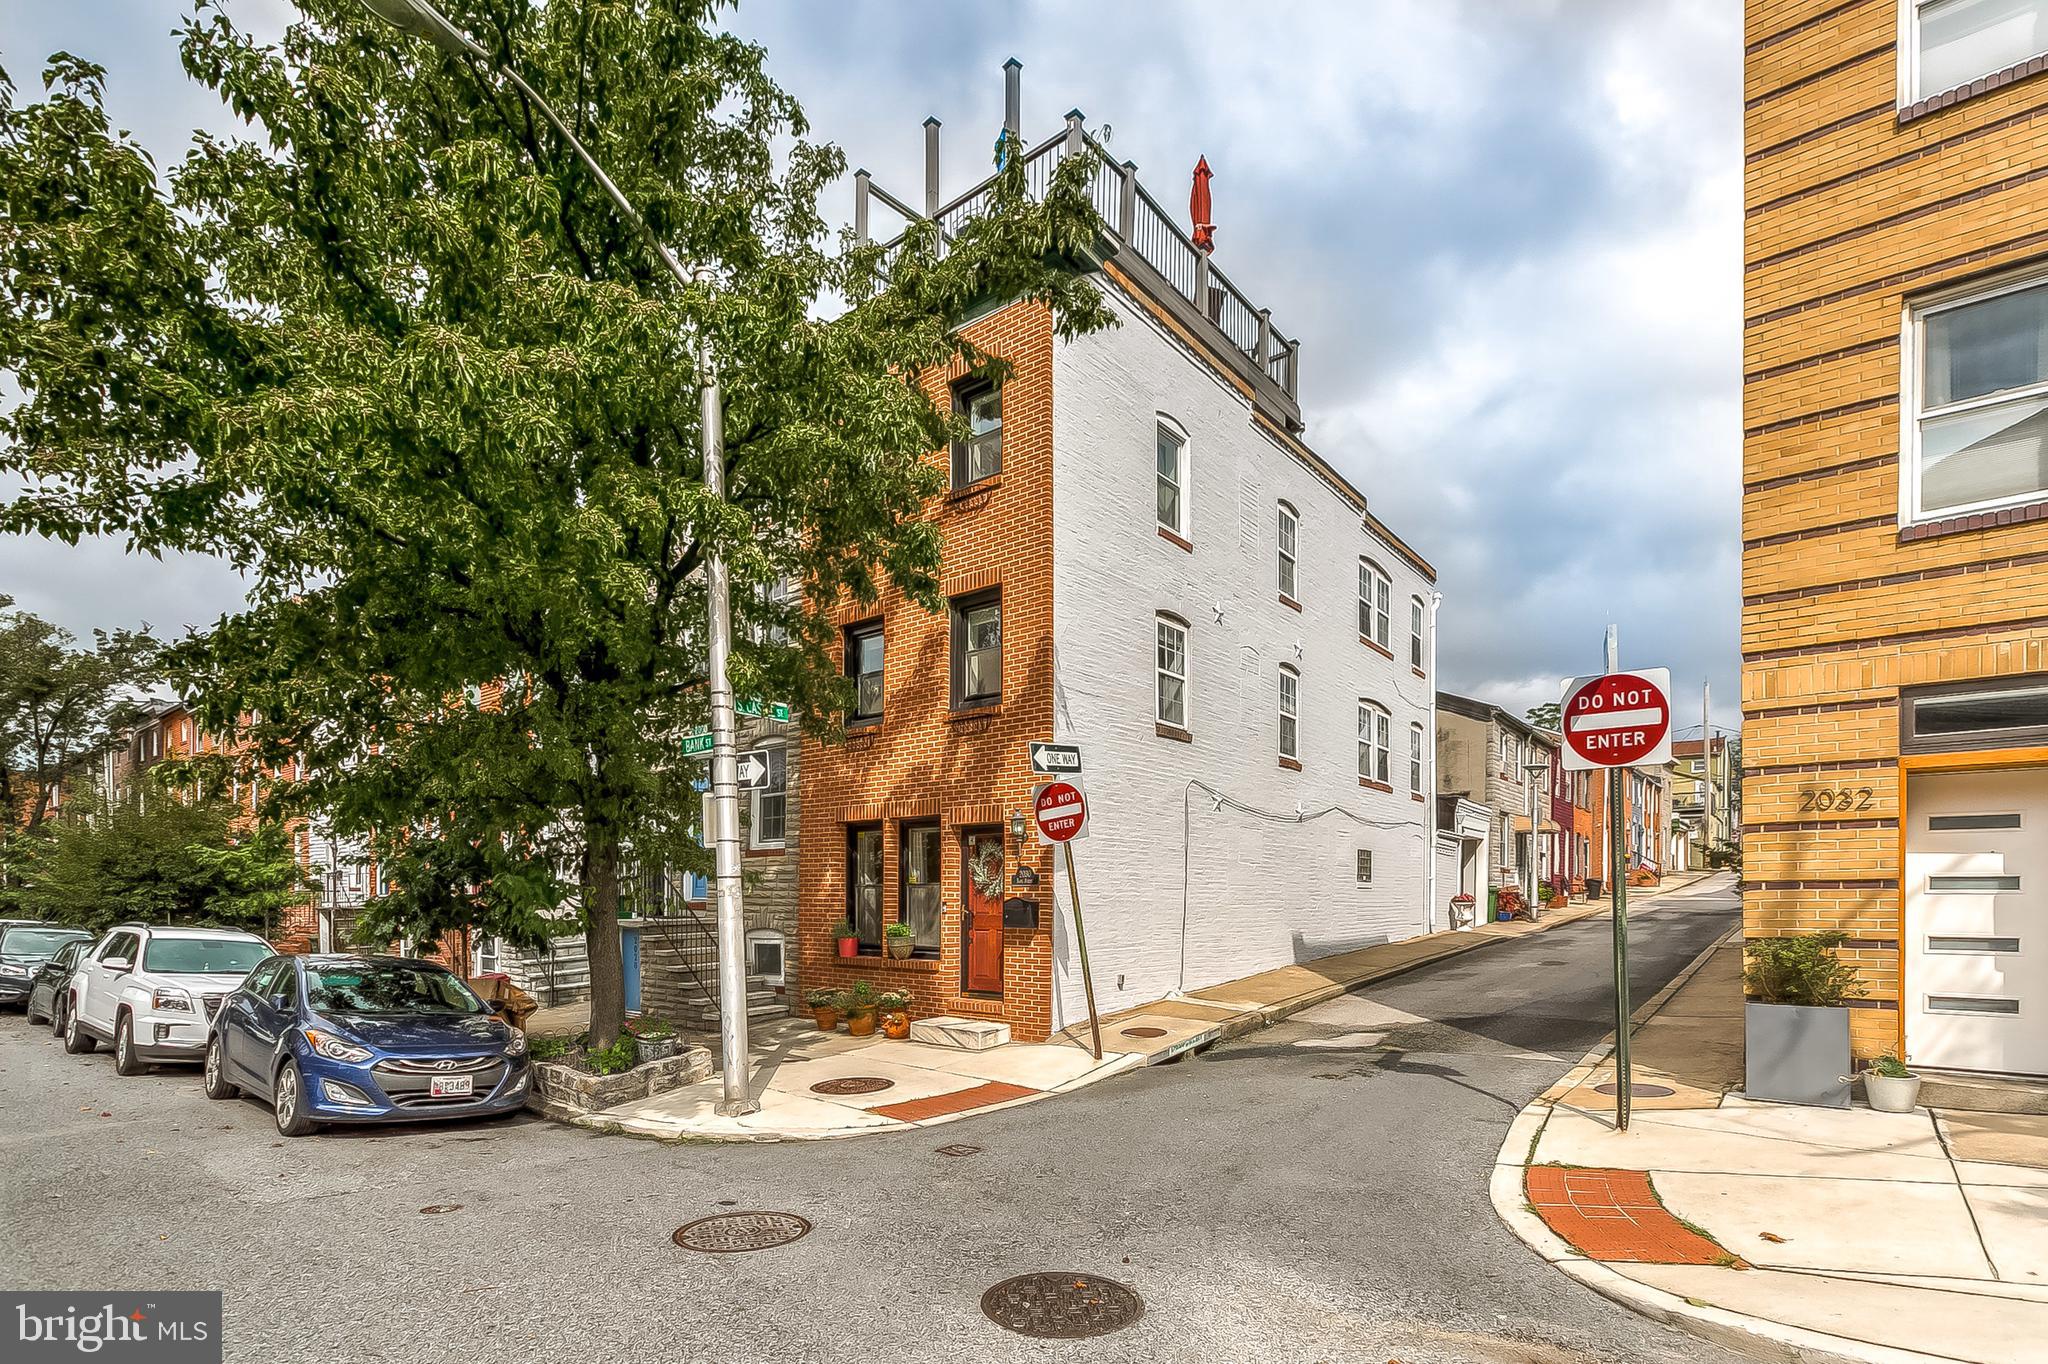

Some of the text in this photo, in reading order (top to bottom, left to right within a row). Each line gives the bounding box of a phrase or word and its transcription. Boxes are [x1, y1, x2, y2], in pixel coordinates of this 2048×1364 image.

[1578, 688, 1652, 710] DO NOT
[685, 738, 712, 753] BANK ST
[1586, 731, 1646, 750] ENTER
[1046, 752, 1076, 765] ONE WAY
[739, 764, 750, 779] AY
[1041, 791, 1076, 808] DO NOT
[1048, 818, 1075, 832] ENTER
